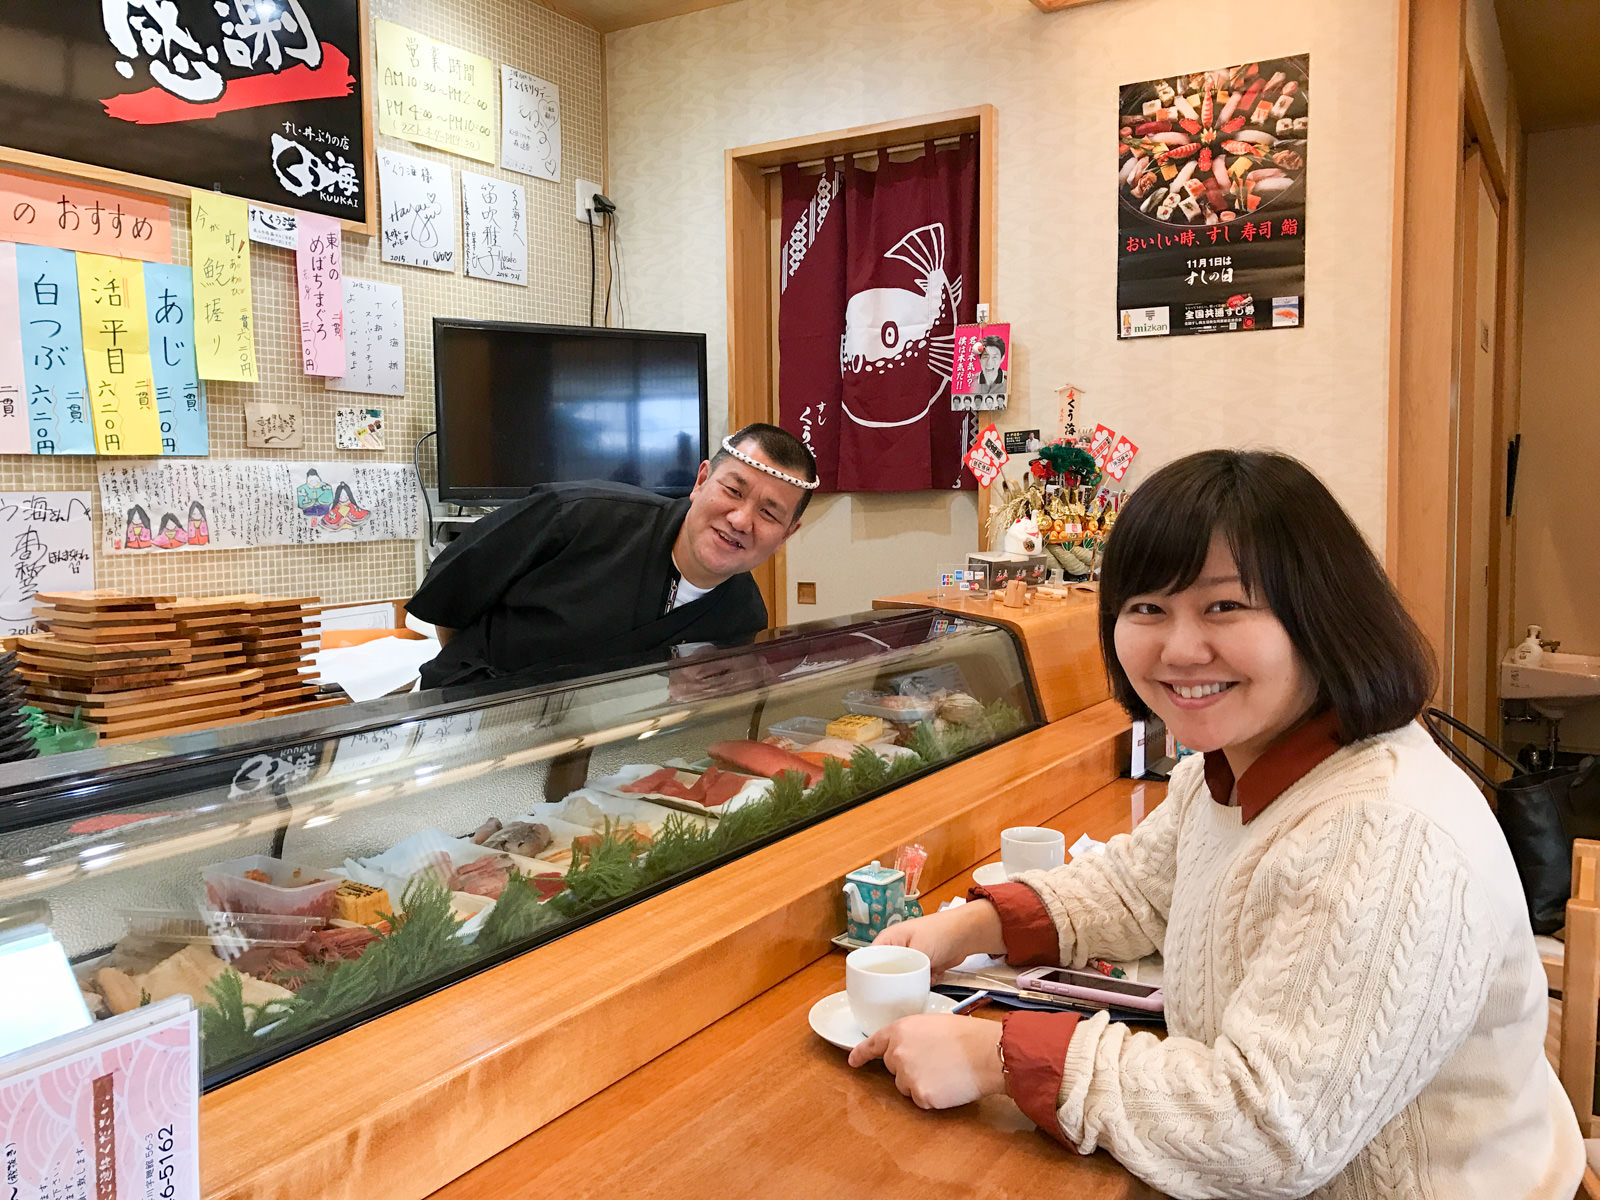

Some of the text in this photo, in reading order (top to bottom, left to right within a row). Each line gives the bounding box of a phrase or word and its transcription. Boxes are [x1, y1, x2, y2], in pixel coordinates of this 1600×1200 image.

[102, 0, 322, 101] 感謝
[320, 191, 359, 208] KUUKAI
[1206, 227, 1231, 245] すし
[1240, 220, 1272, 241] 寿司
[1184, 267, 1234, 286] すしの日
[1186, 256, 1232, 269] 11月1日は
[309, 234, 328, 342] めばちまぐろ
[29, 273, 69, 371] 白つぶ
[91, 276, 128, 374] 活平目
[155, 288, 185, 367] あじ
[1134, 322, 1168, 334] mizkan
[799, 406, 817, 458] くう
[815, 401, 827, 426] すし
[1065, 398, 1077, 436] くう海
[157, 1123, 175, 1200] 6-5162
